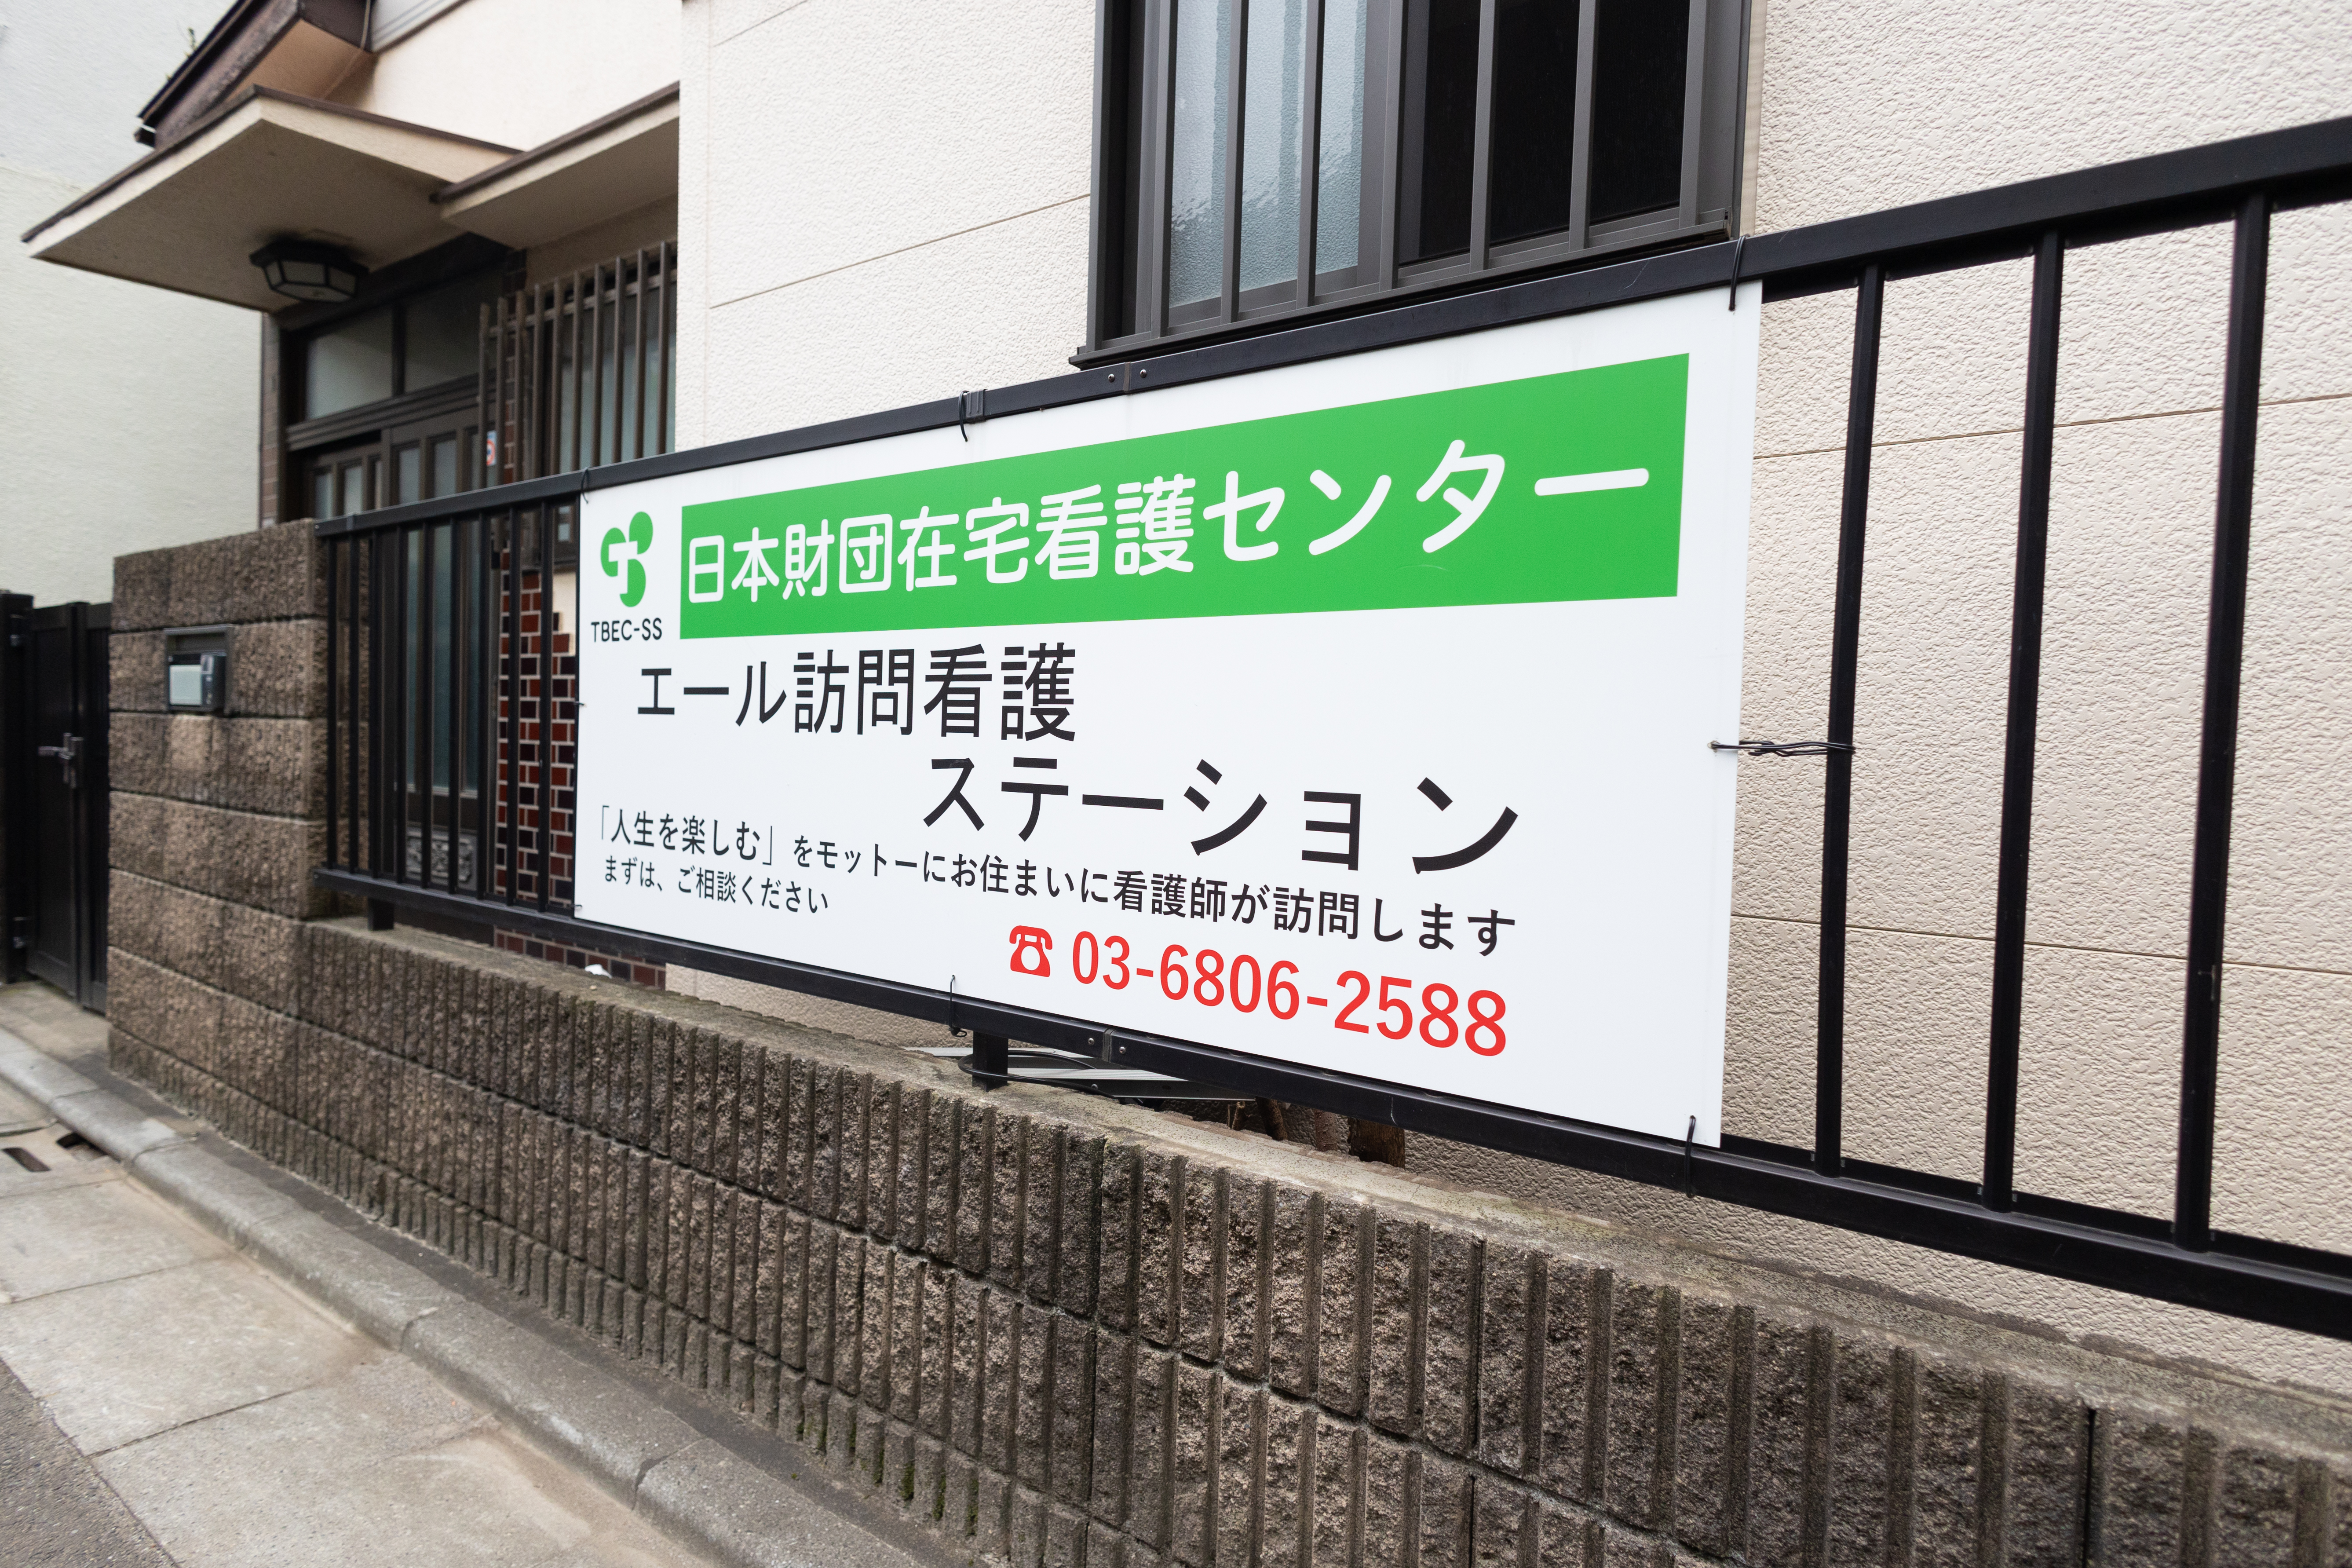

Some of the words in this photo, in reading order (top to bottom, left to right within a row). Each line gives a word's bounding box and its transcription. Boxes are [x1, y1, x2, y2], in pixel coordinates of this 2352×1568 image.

[688, 439, 1649, 603] 日本財団在宅看護センター
[591, 617, 662, 642] TBEC-SS
[637, 642, 1076, 742] エール訪問看護
[923, 757, 1519, 874] ステーション
[601, 805, 1516, 957] 「人生を楽しむ」をモットーにお住まいに看護師が訪問します
[605, 855, 829, 914] まずは、ご相談ください
[1072, 930, 1507, 1057] 03-6806-2588
